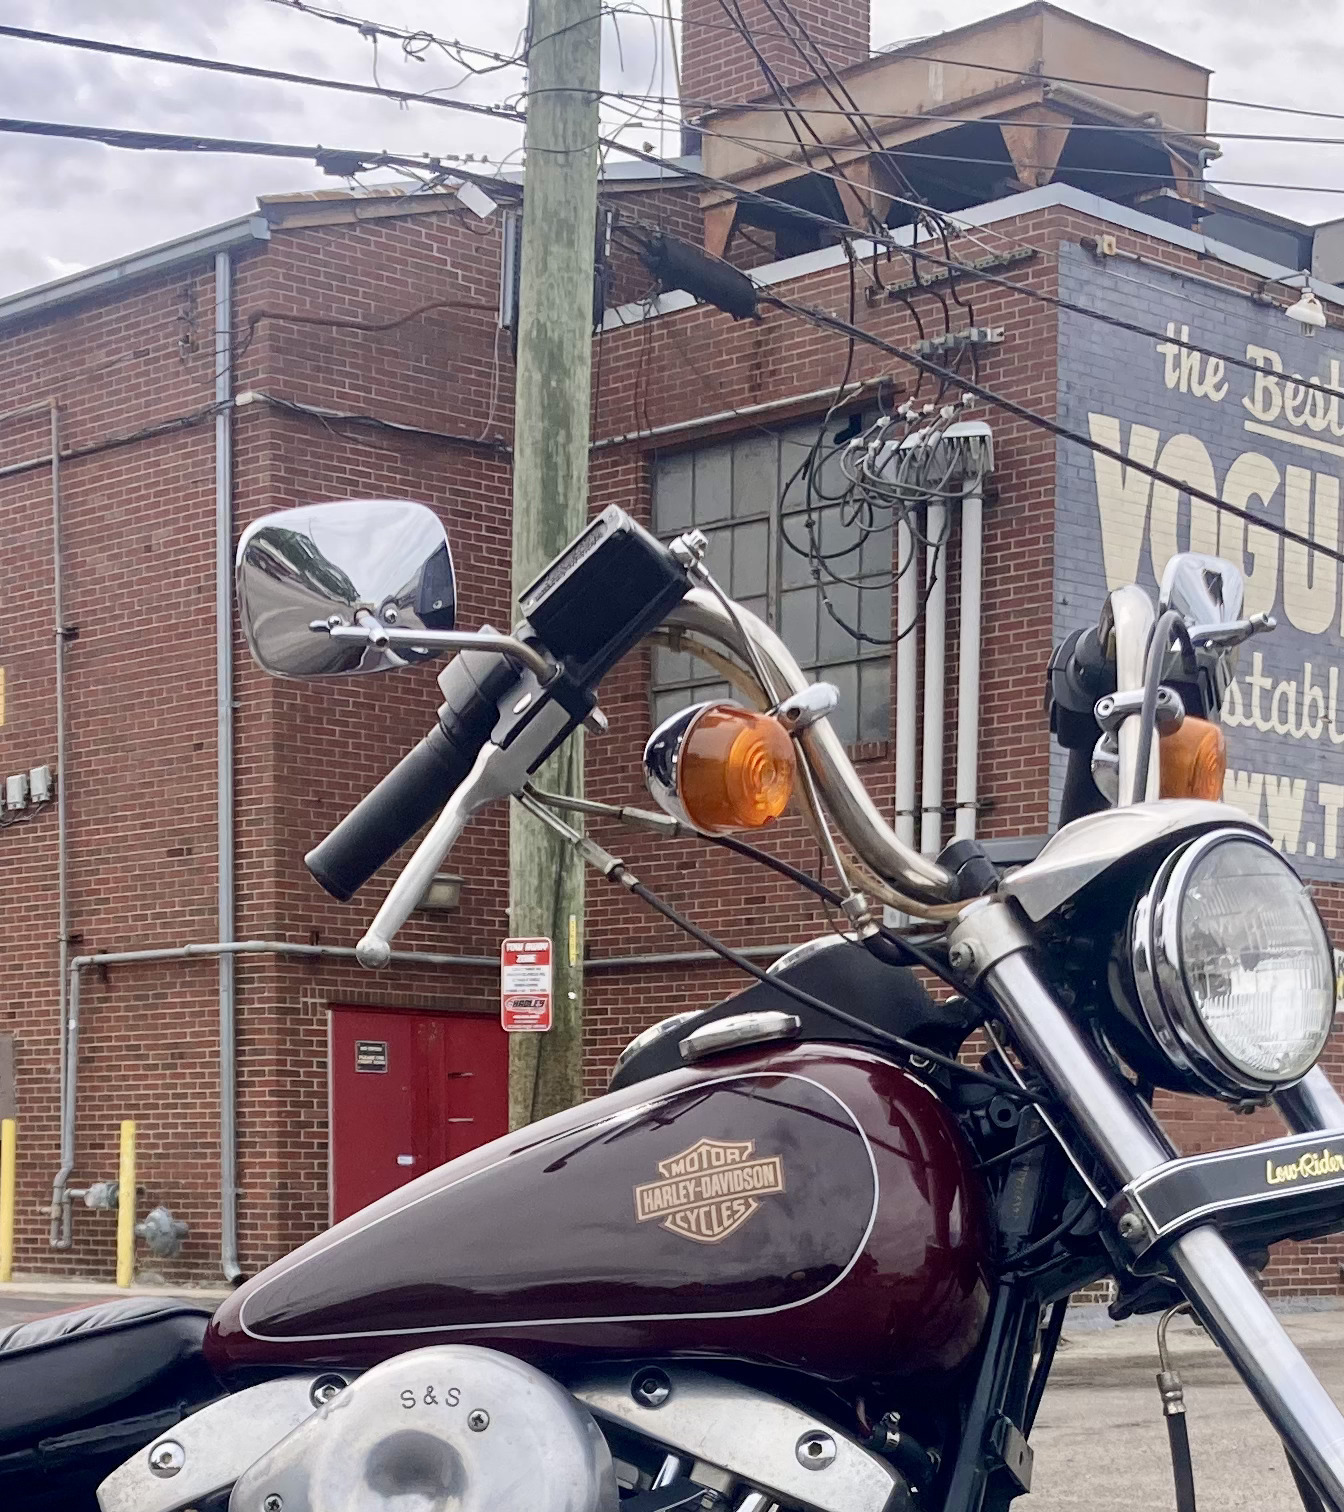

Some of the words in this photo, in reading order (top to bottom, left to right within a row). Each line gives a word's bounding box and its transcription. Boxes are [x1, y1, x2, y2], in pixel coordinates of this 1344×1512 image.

[1156, 322, 1229, 402] the
[671, 1148, 740, 1177] MOTOR
[642, 1163, 775, 1213] HARLEY-DAVIDSON
[675, 1199, 746, 1236] CYCLES
